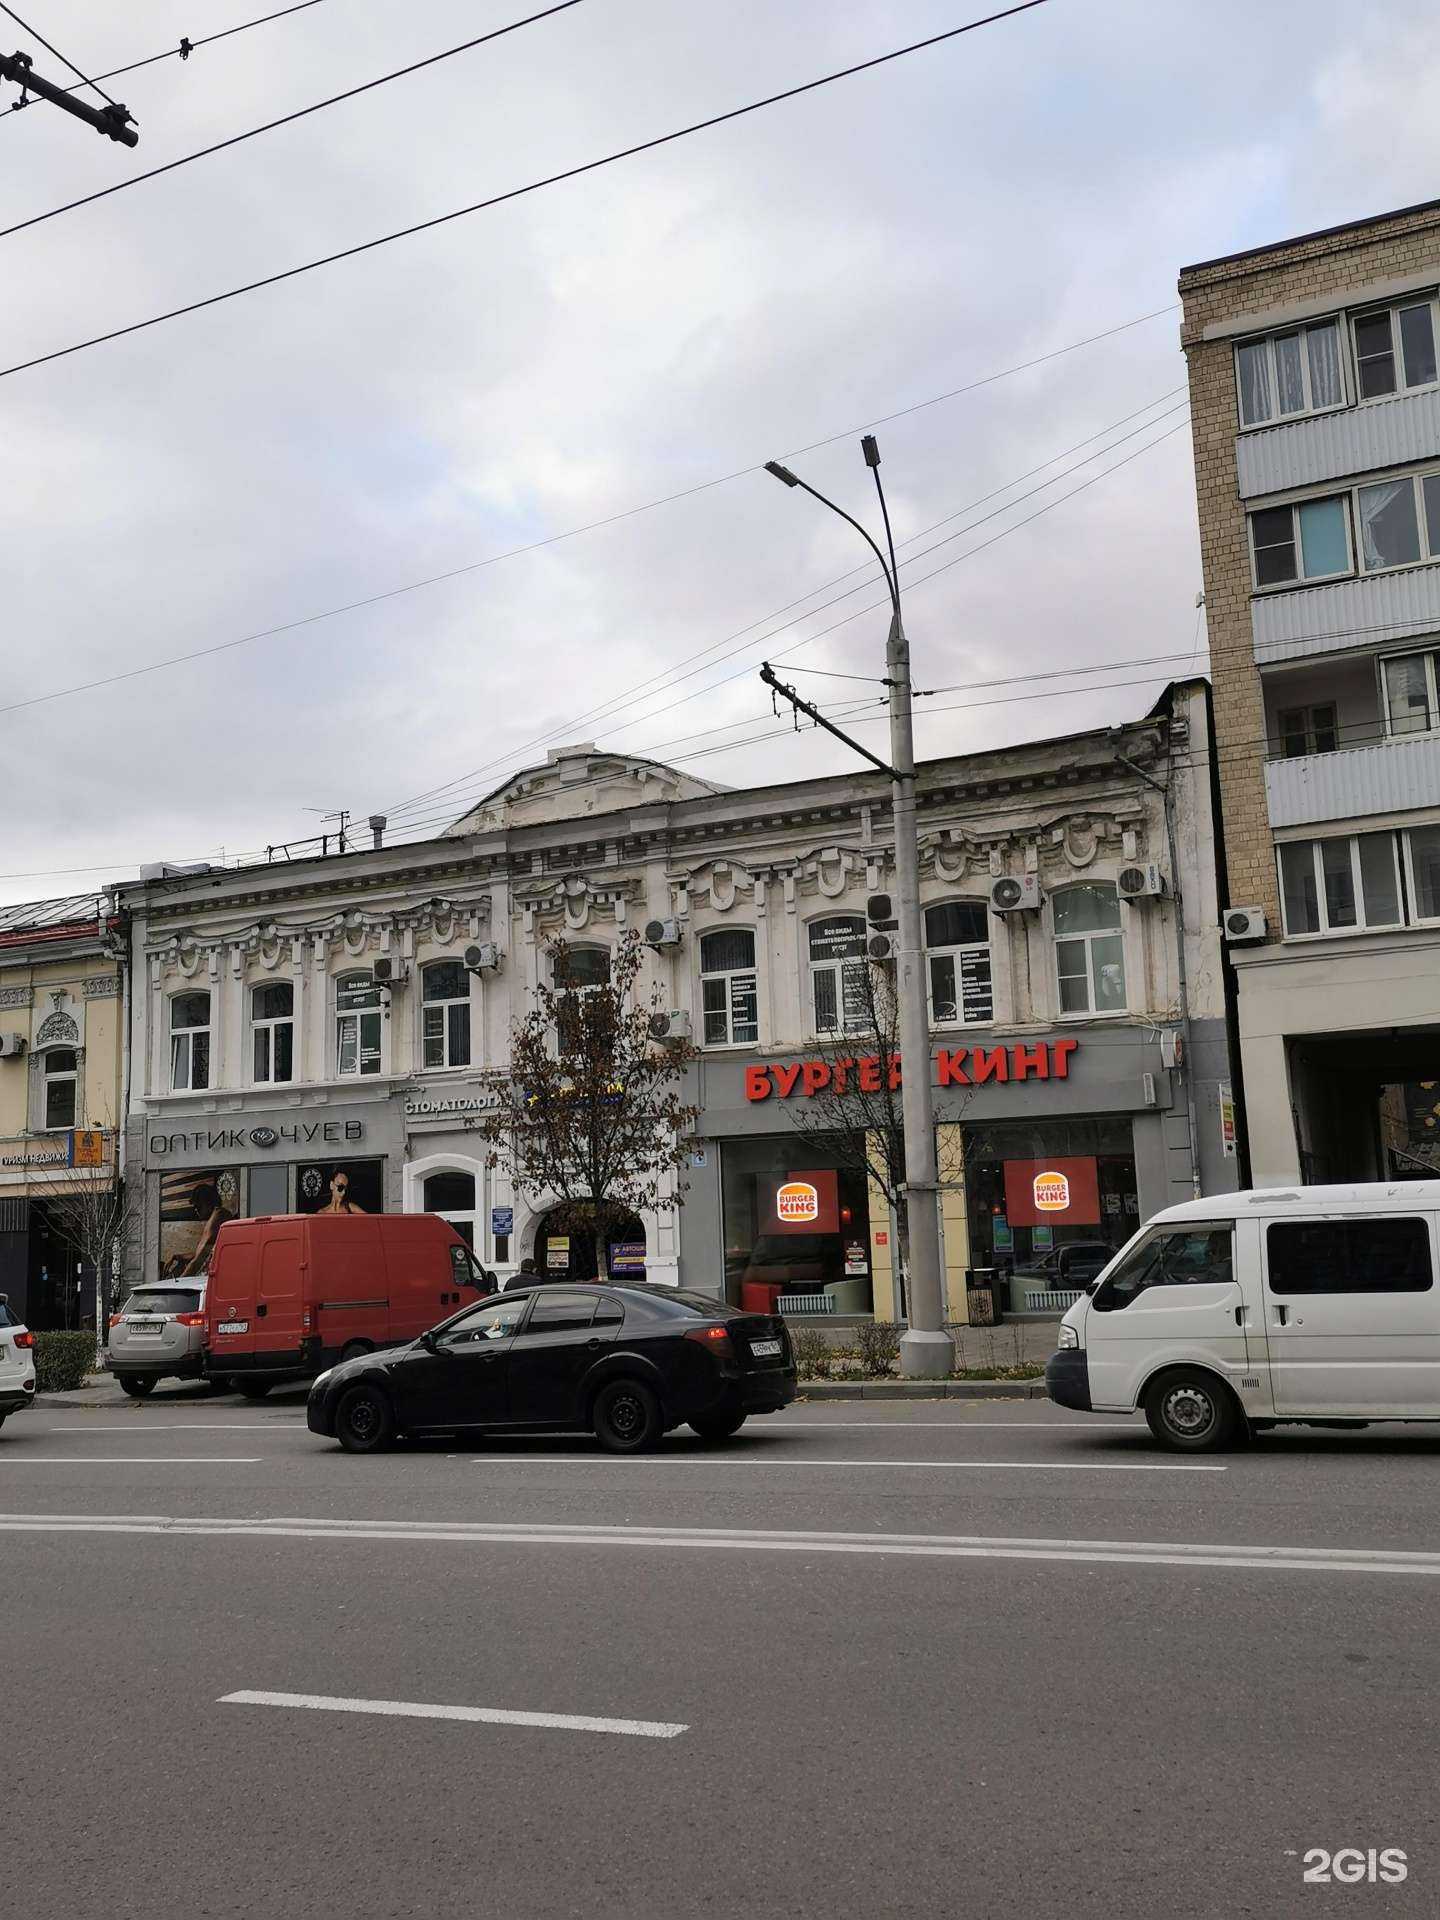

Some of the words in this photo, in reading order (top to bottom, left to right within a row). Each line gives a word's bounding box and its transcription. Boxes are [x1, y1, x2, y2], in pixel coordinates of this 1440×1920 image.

[937, 1039, 1079, 1086] КИНГ
[280, 1120, 362, 1143] ЧУЕВ
[780, 1194, 815, 1203] BURGER
[1036, 1191, 1067, 1202] KING
[780, 1202, 816, 1213] KING
